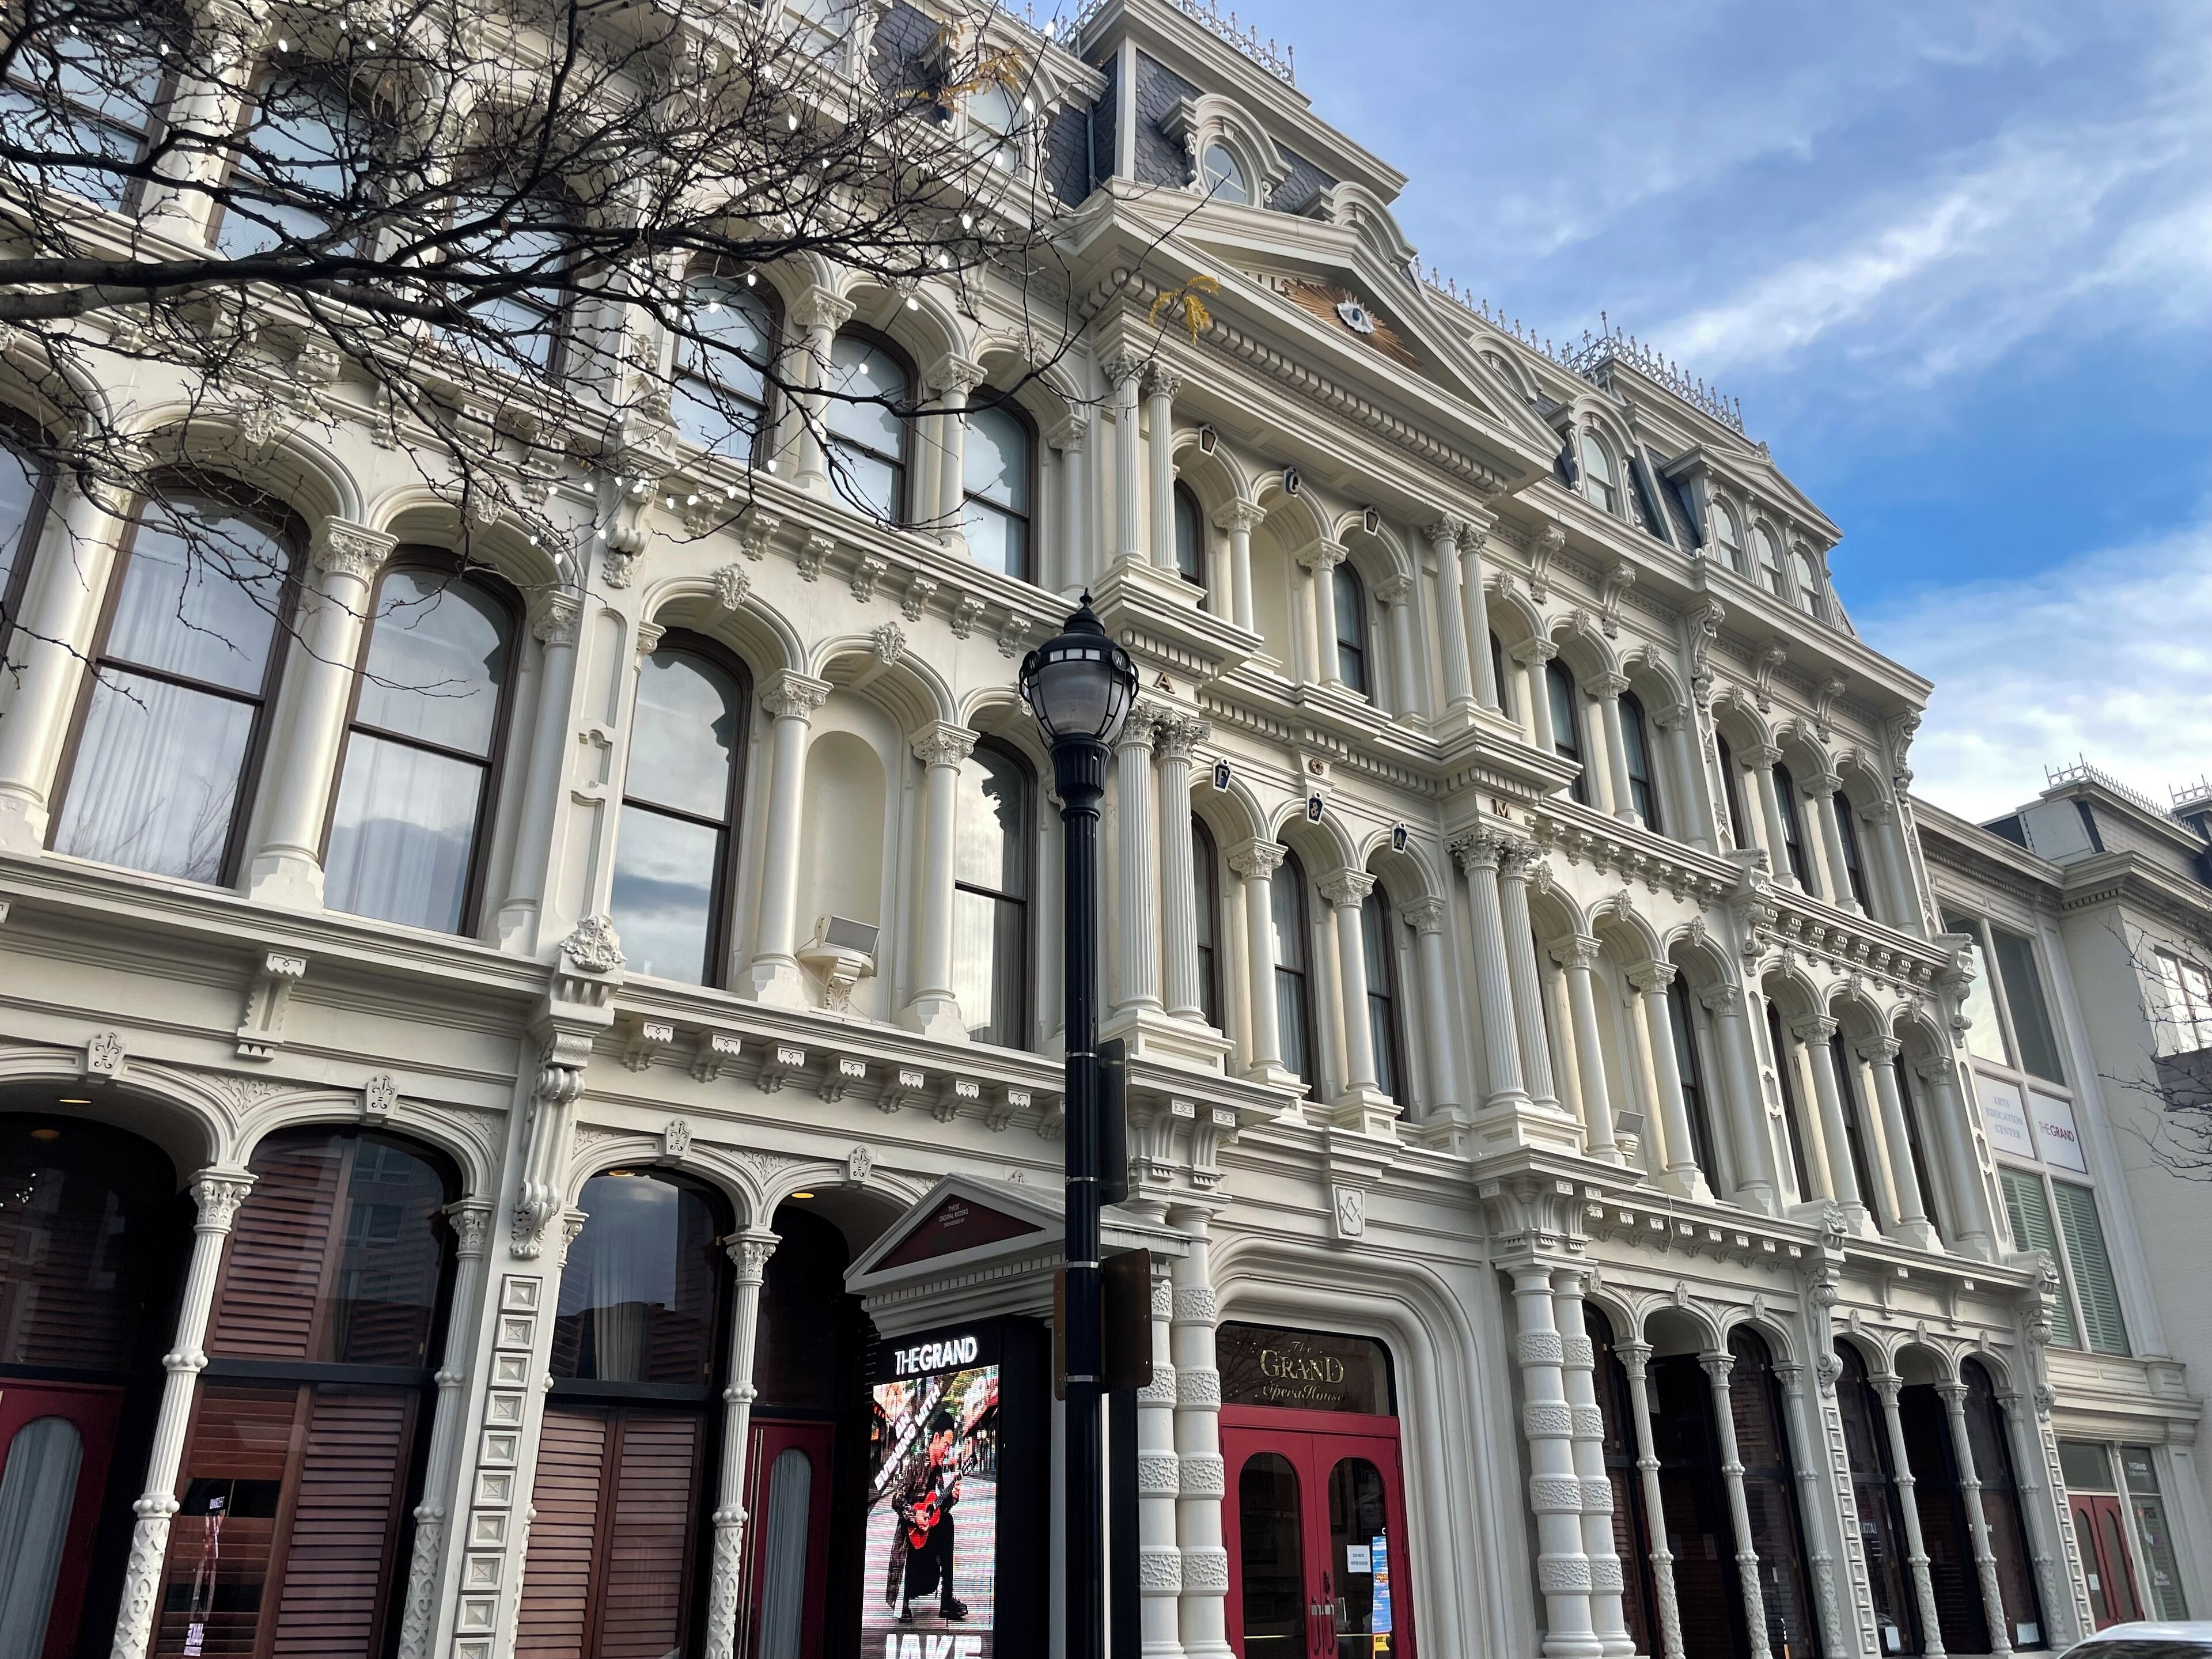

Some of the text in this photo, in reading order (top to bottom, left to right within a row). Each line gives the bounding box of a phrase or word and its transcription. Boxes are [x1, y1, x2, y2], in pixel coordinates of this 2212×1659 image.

[1029, 657, 1036, 670] W
[1114, 654, 1123, 667] W
[1152, 672, 1176, 694] A
[1216, 767, 1229, 785] F
[1395, 831, 1403, 848] A
[1493, 798, 1512, 819] M
[1994, 1097, 2010, 1108] ARTS
[1986, 1107, 2024, 1125] EDUCATION
[1995, 1124, 2021, 1139] CENTER
[939, 1209, 968, 1222] DIGITAL KIOSKS
[948, 1203, 960, 1212] THESE
[1290, 1341, 1312, 1353] The
[1260, 1349, 1344, 1384] GRAND
[1263, 1380, 1346, 1402] Opera House
[914, 1384, 942, 1427] WITH
[895, 1410, 912, 1440] AN
[874, 1423, 917, 1492] EVENING
